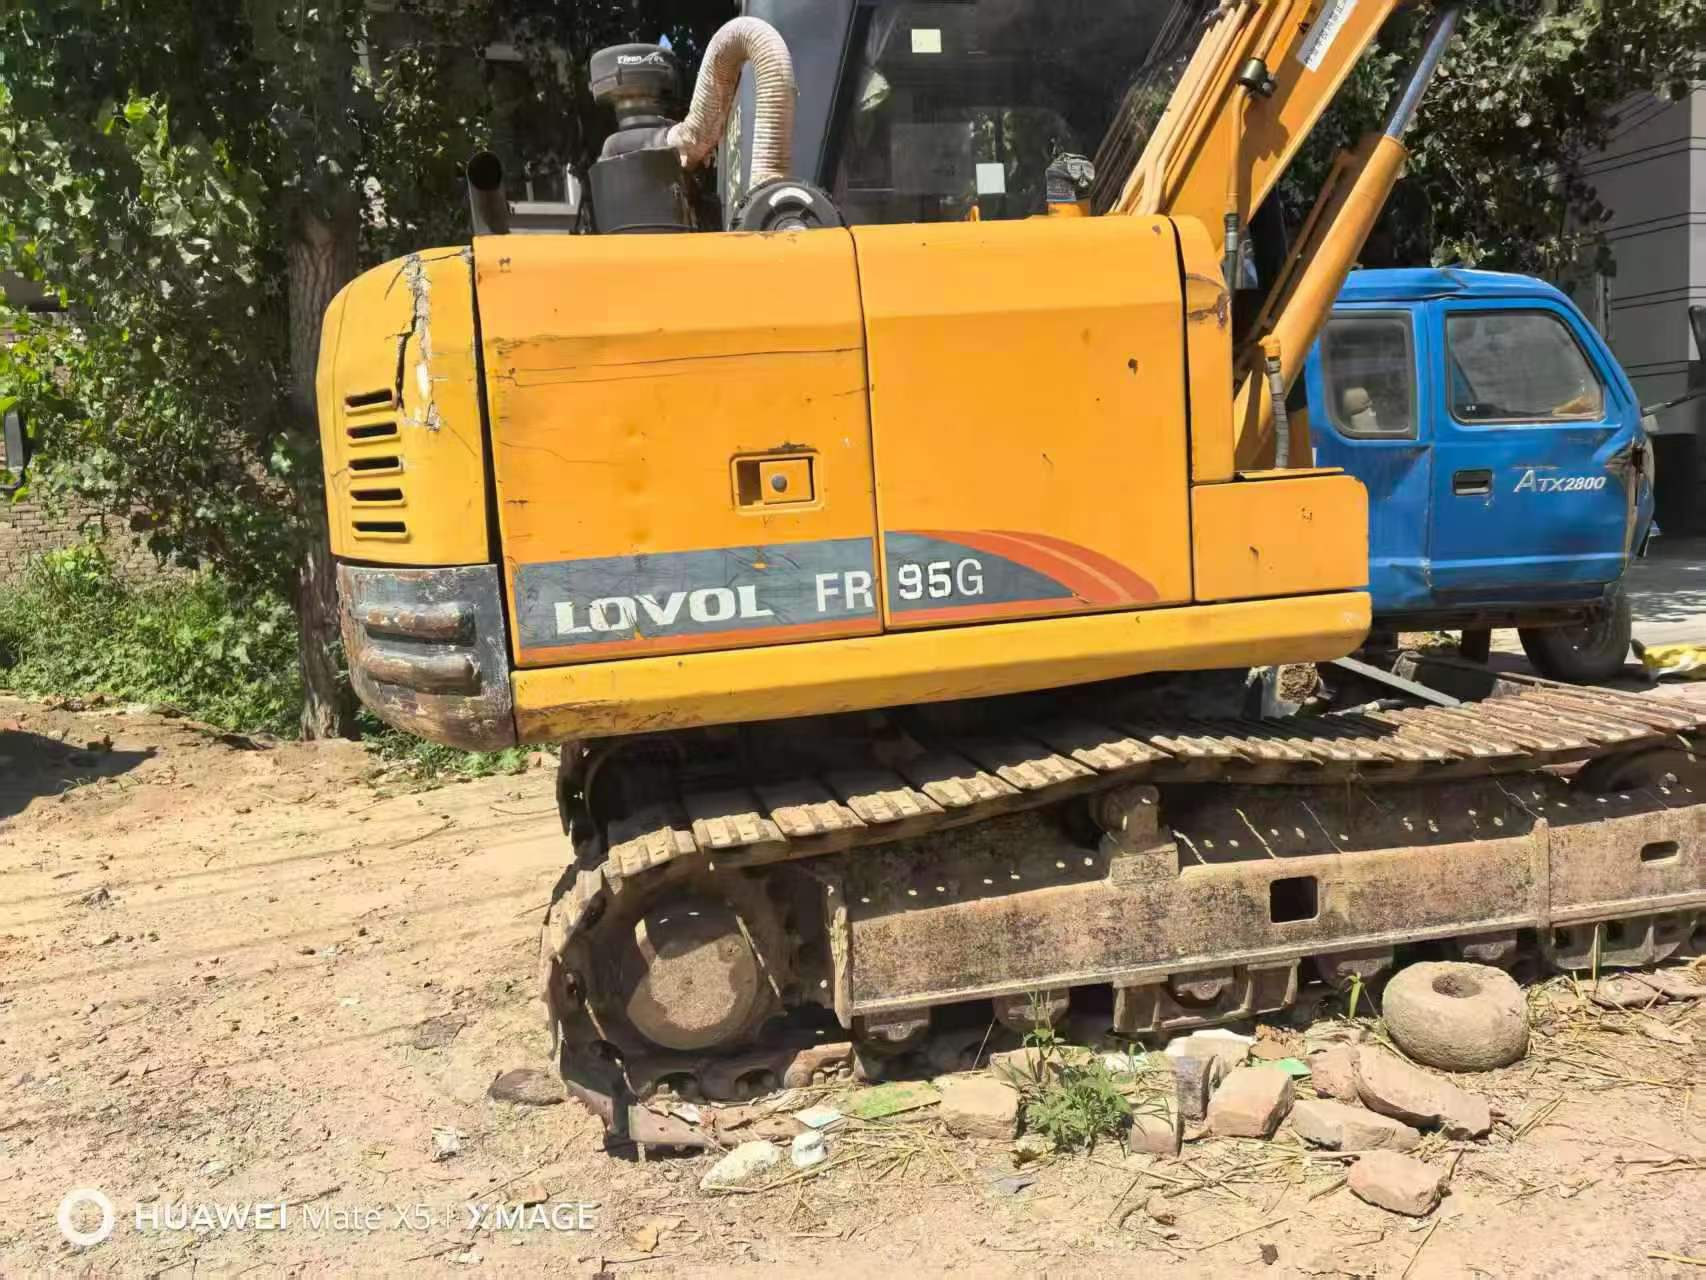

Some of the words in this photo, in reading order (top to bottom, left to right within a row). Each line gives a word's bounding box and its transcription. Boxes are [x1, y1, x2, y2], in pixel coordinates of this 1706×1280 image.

[554, 584, 774, 635] LOVOL
[815, 570, 874, 613] FR
[898, 558, 984, 600] 95G
